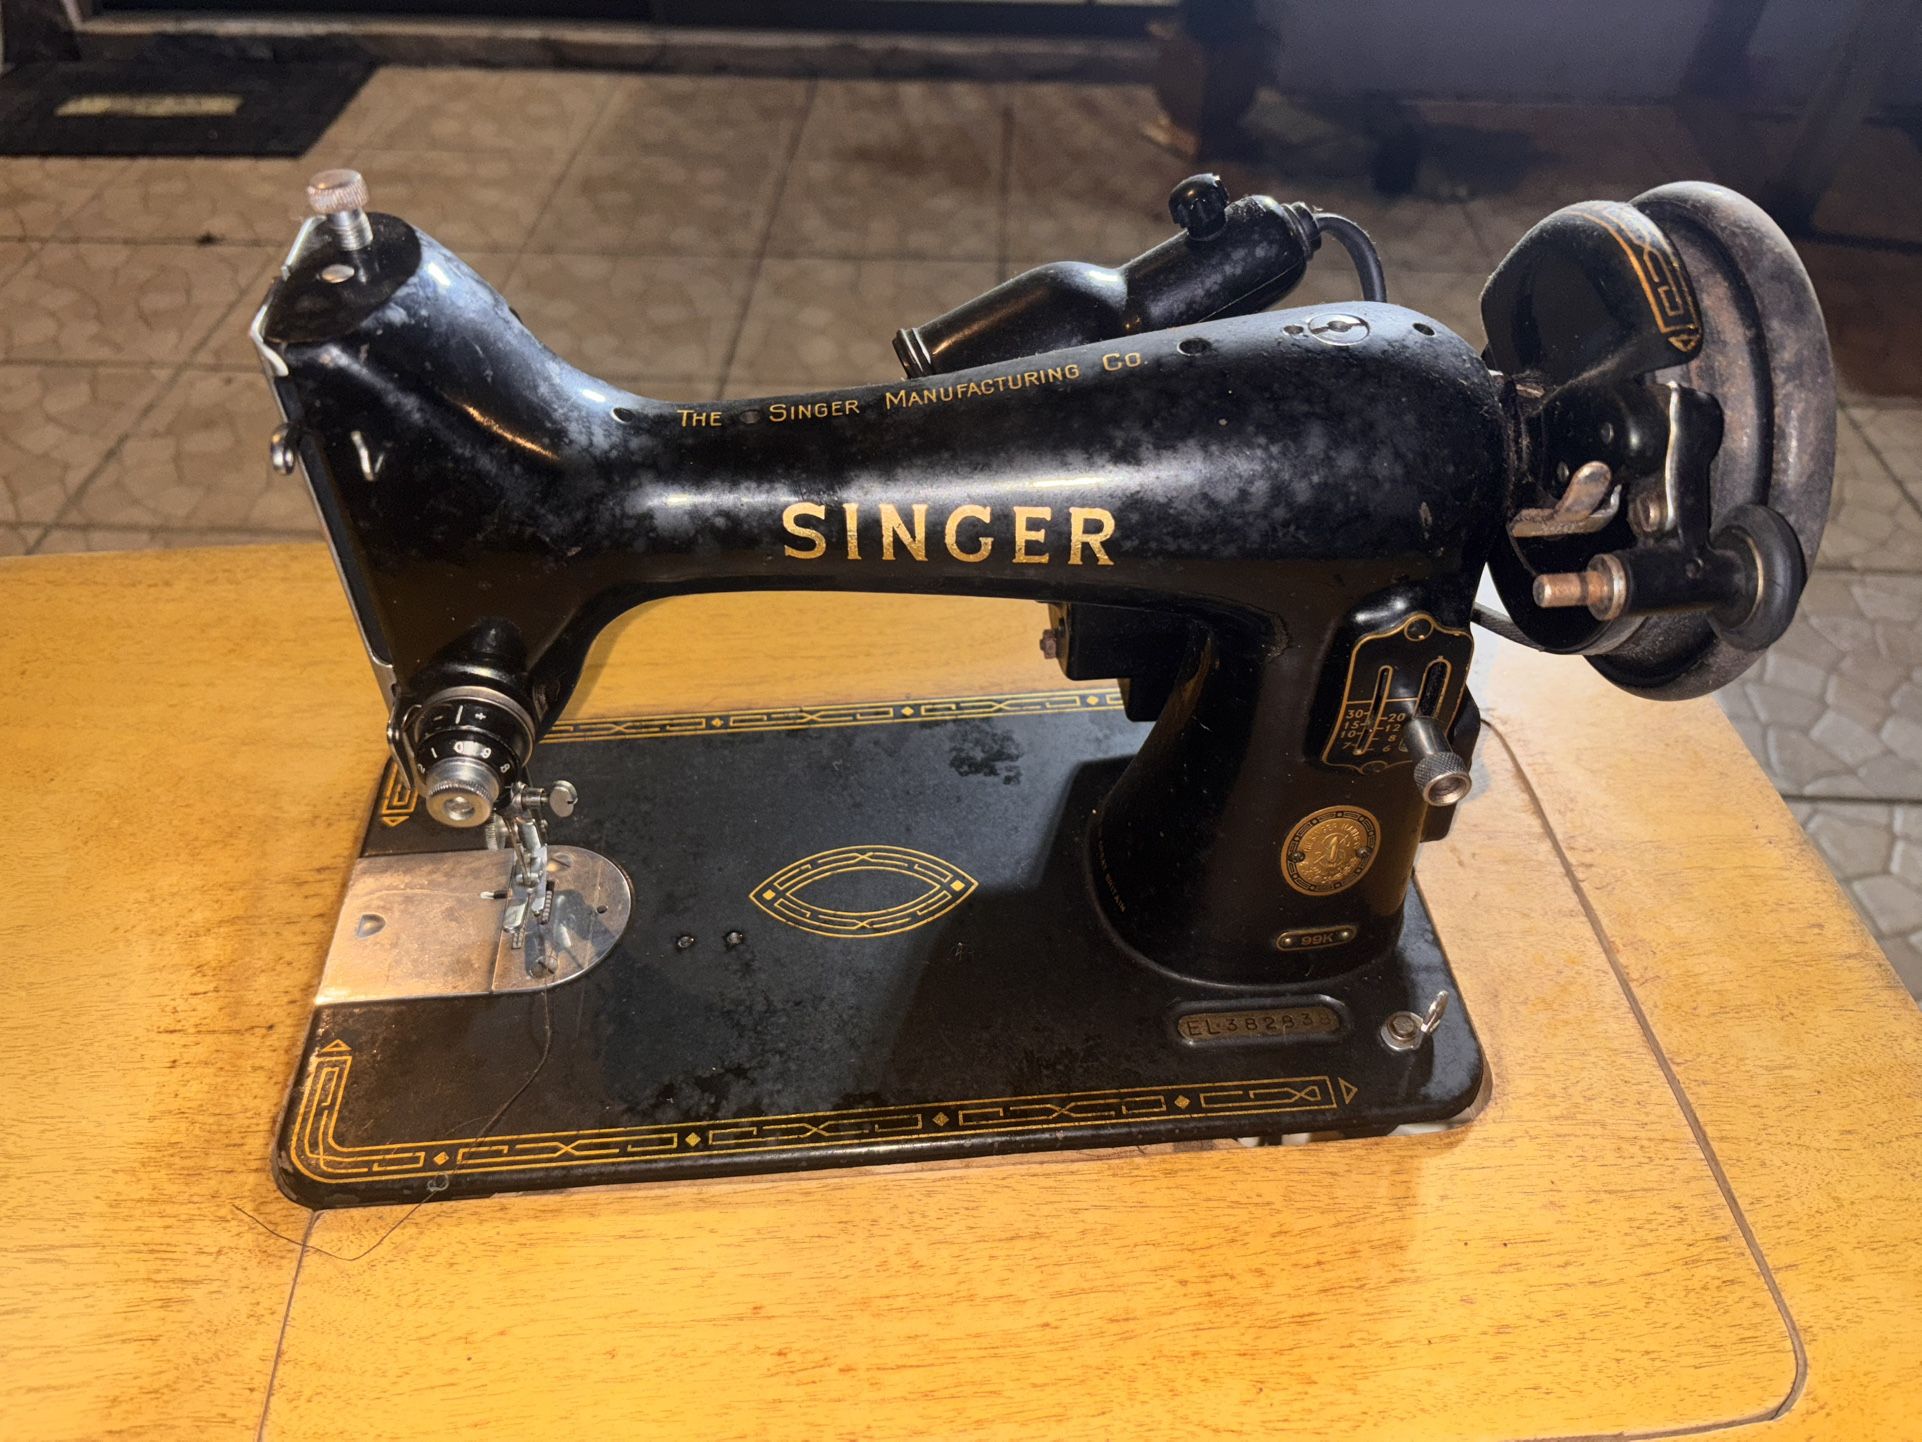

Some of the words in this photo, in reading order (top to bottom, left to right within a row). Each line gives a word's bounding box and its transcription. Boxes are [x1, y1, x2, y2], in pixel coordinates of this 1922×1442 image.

[676, 408, 722, 428] THE
[768, 399, 861, 423] SINGER
[885, 363, 1080, 410] MANUFACTURING
[782, 502, 1116, 566] SINGER
[1346, 709, 1364, 719] 30
[1387, 712, 1406, 722] 20
[1344, 720, 1360, 729] 15
[1385, 723, 1401, 732] 12
[1340, 730, 1357, 738] 10
[480, 747, 492, 759] 9
[500, 763, 511, 773] 8
[1301, 932, 1334, 945] 99K
